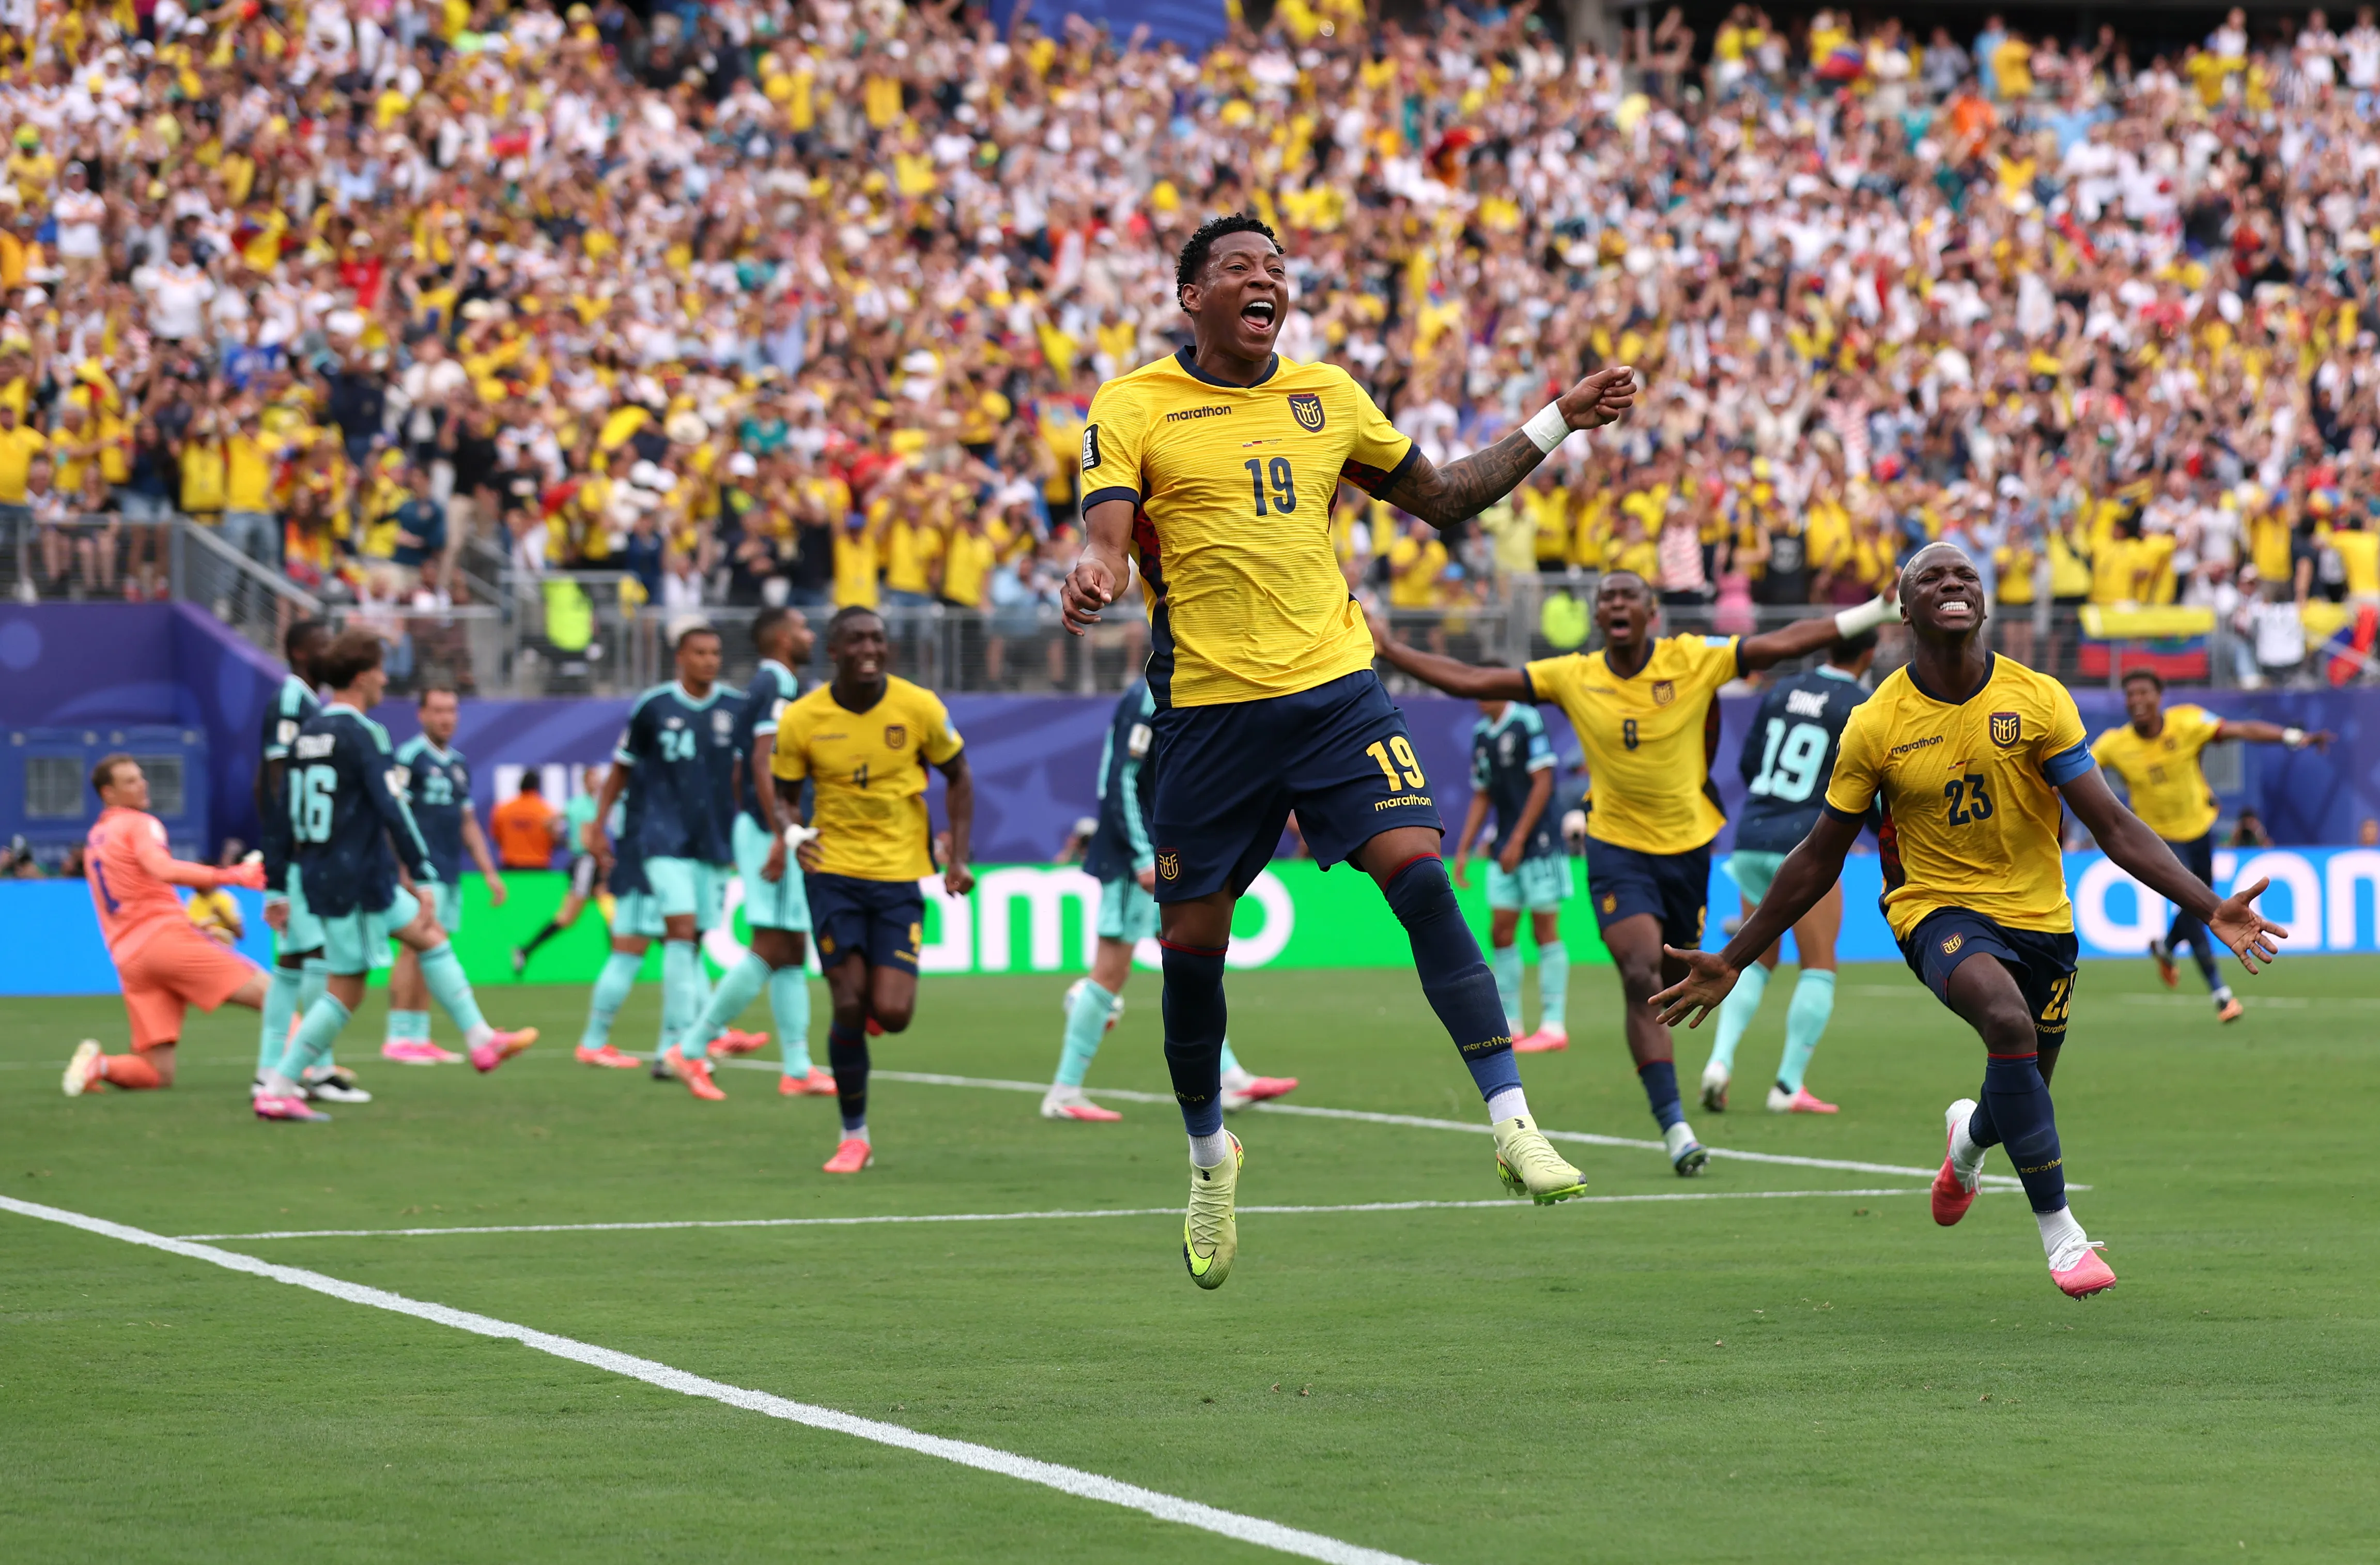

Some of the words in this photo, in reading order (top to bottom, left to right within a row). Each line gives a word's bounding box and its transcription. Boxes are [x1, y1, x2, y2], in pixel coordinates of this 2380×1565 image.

[1167, 406, 1231, 422] marathon
[1244, 457, 1296, 516] 19
[657, 729, 697, 762] 24
[1623, 718, 1639, 749] 8
[1891, 734, 1944, 755] marathon
[1366, 736, 1425, 792] 19
[1749, 717, 1830, 802] 19
[288, 763, 337, 843] 16
[1374, 794, 1432, 811] marathon
[1944, 773, 1993, 826] 23
